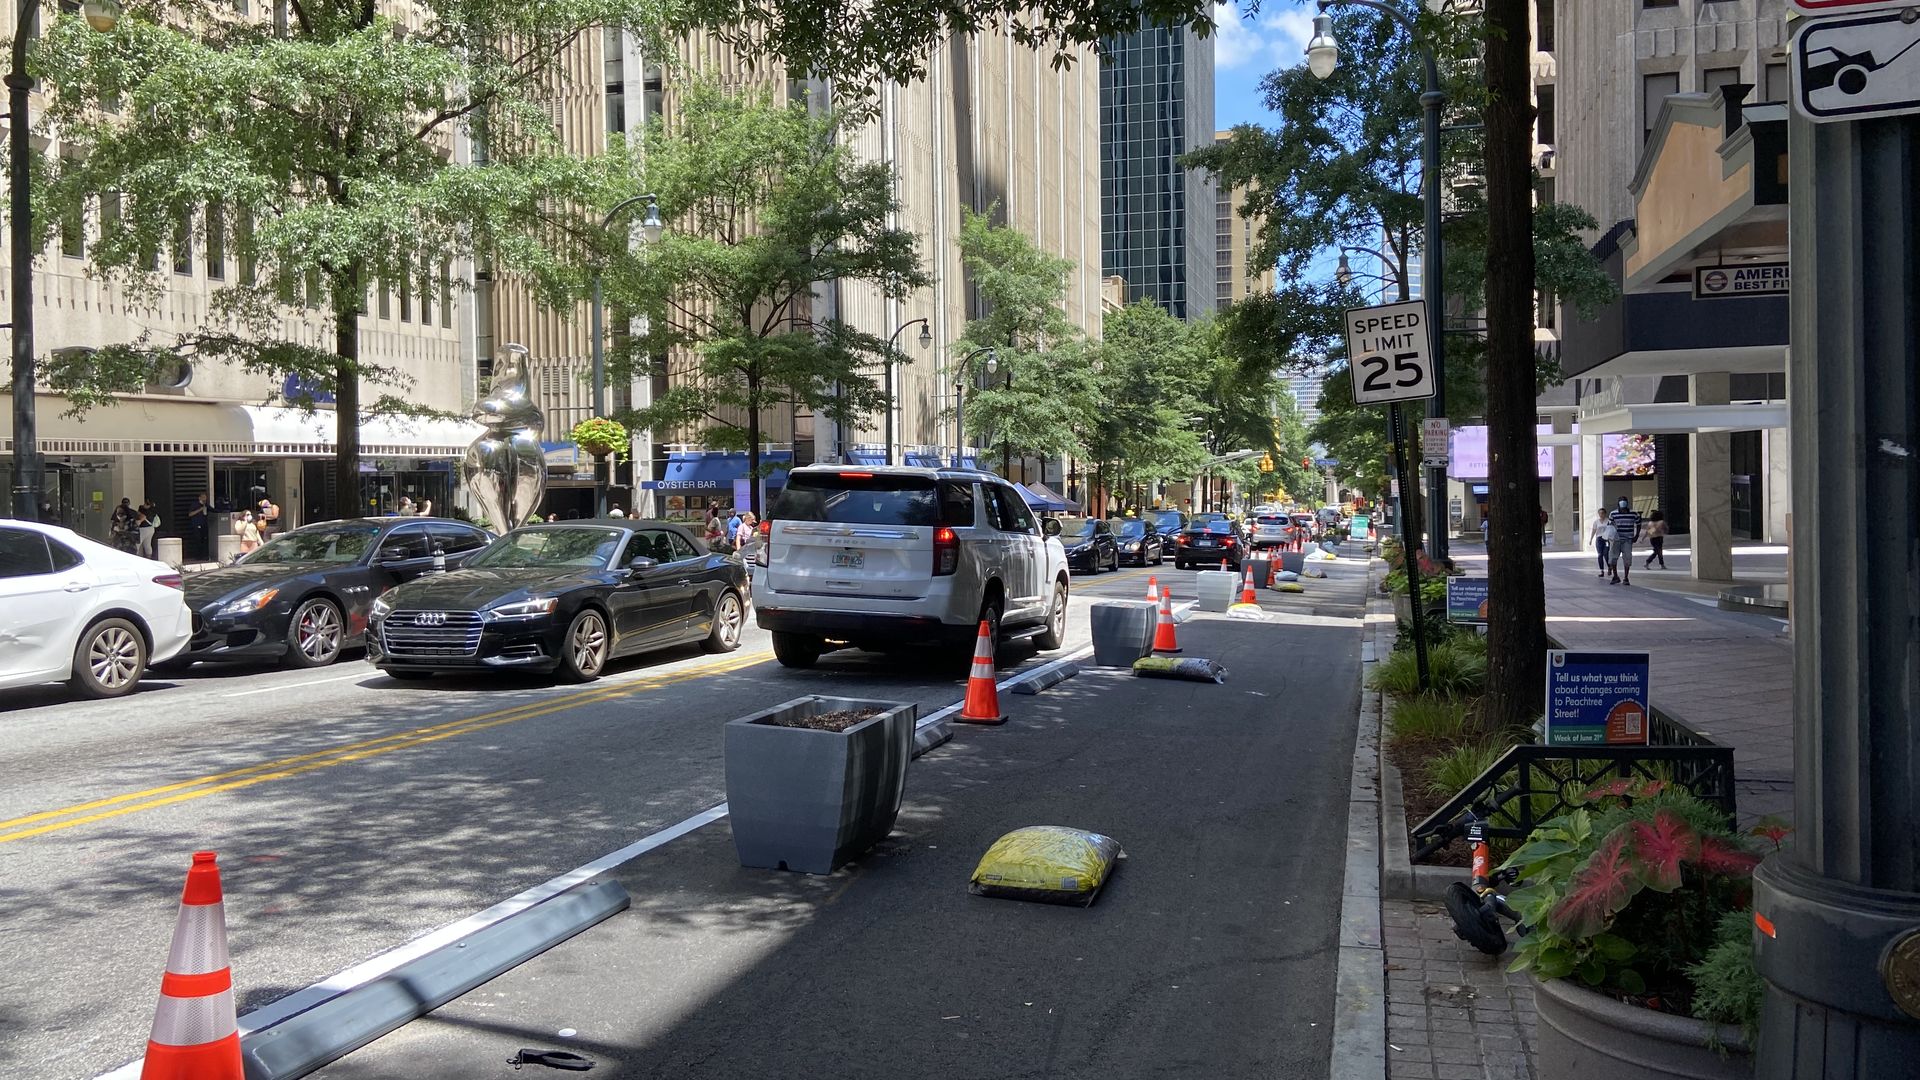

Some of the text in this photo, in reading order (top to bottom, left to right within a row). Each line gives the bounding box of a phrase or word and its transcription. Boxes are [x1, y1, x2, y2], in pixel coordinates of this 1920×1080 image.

[1734, 281, 1768, 290] BEST
[1354, 313, 1420, 334] SPEED
[1362, 333, 1414, 352] LIMIT
[1360, 352, 1424, 392] 25
[1555, 673, 1568, 682] Tell
[1582, 673, 1602, 682] what
[1604, 675, 1618, 684] you
[1620, 673, 1638, 682] think
[1555, 685, 1640, 696] about changes coming
[1555, 697, 1602, 706] to Peachtree
[1554, 708, 1579, 718] Street!
